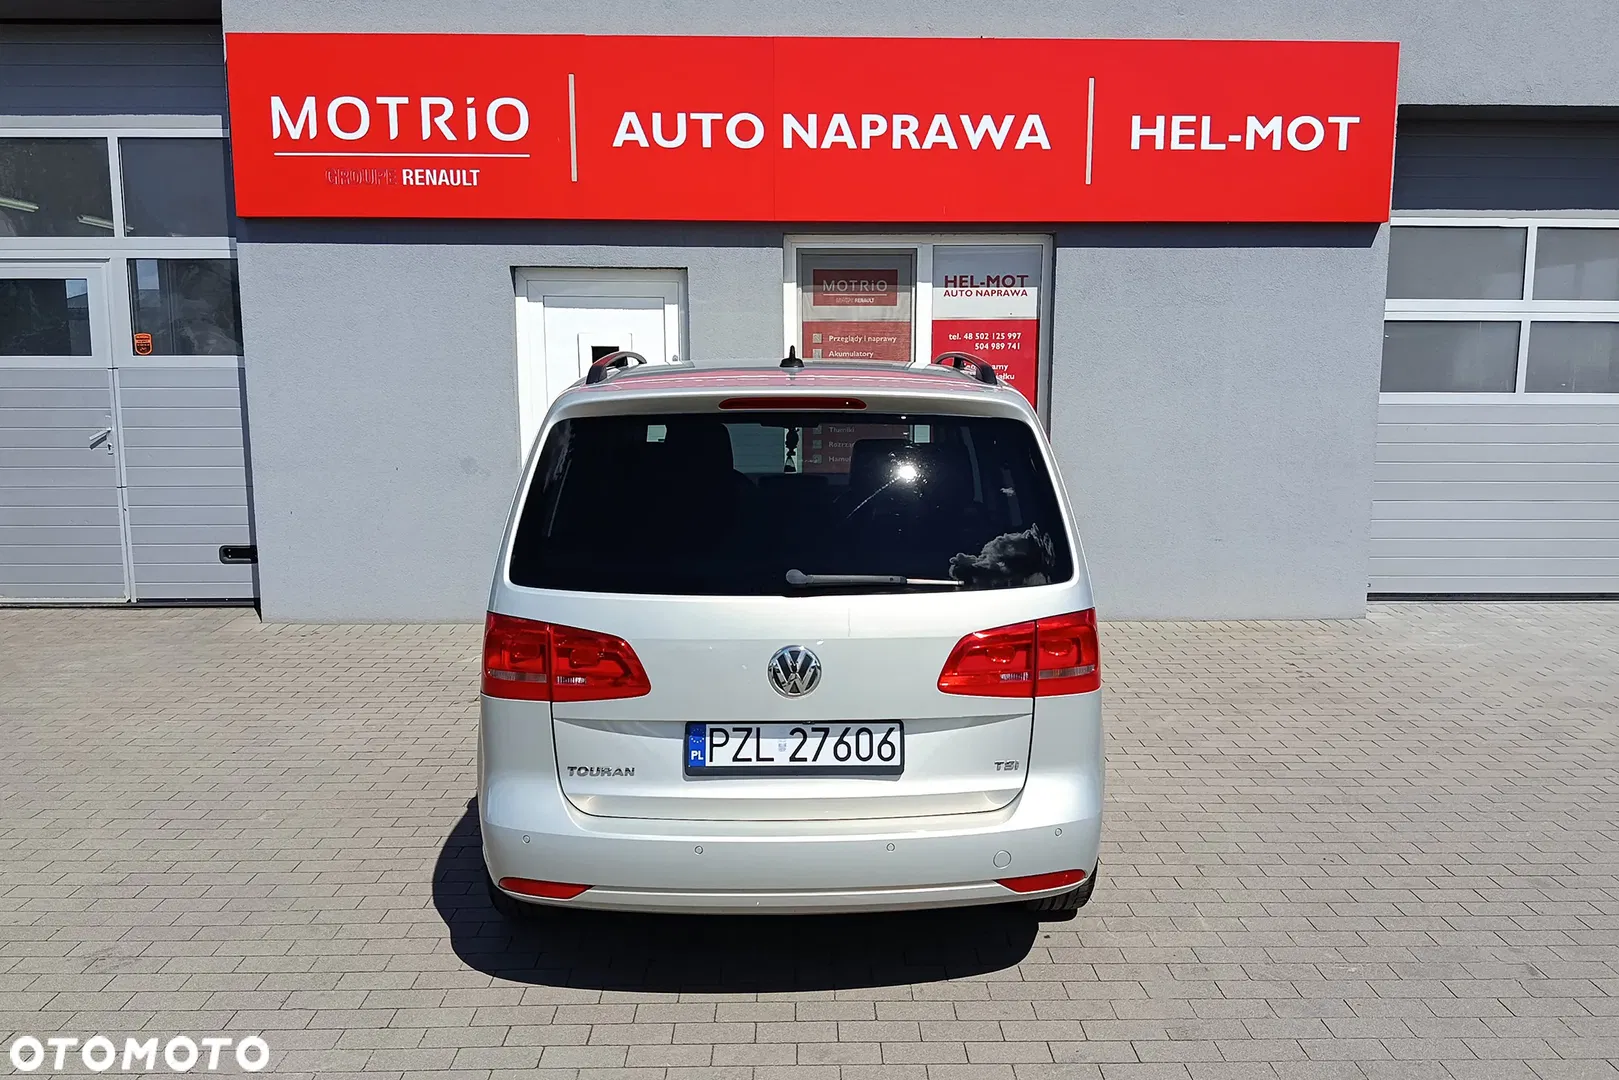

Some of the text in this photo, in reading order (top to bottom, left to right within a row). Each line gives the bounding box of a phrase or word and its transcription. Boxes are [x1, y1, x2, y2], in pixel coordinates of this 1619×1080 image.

[612, 111, 1052, 150] AUTO NAPRAWA
[1130, 115, 1361, 151] HEL-MOT
[324, 167, 480, 187] GROUPE RENAULT
[944, 274, 1029, 288] HEL-MOT
[943, 289, 1028, 297] AUTO NAPRAWA
[828, 335, 862, 343] Przeglądy
[867, 336, 897, 344] naprawy
[948, 332, 1022, 340] tel. 48 502 125 997
[974, 342, 1020, 350] 504 989 741
[828, 350, 874, 358] Akumulatory
[709, 727, 896, 763] PZL 27606
[691, 750, 704, 760] PL
[567, 766, 635, 777] TOURAN
